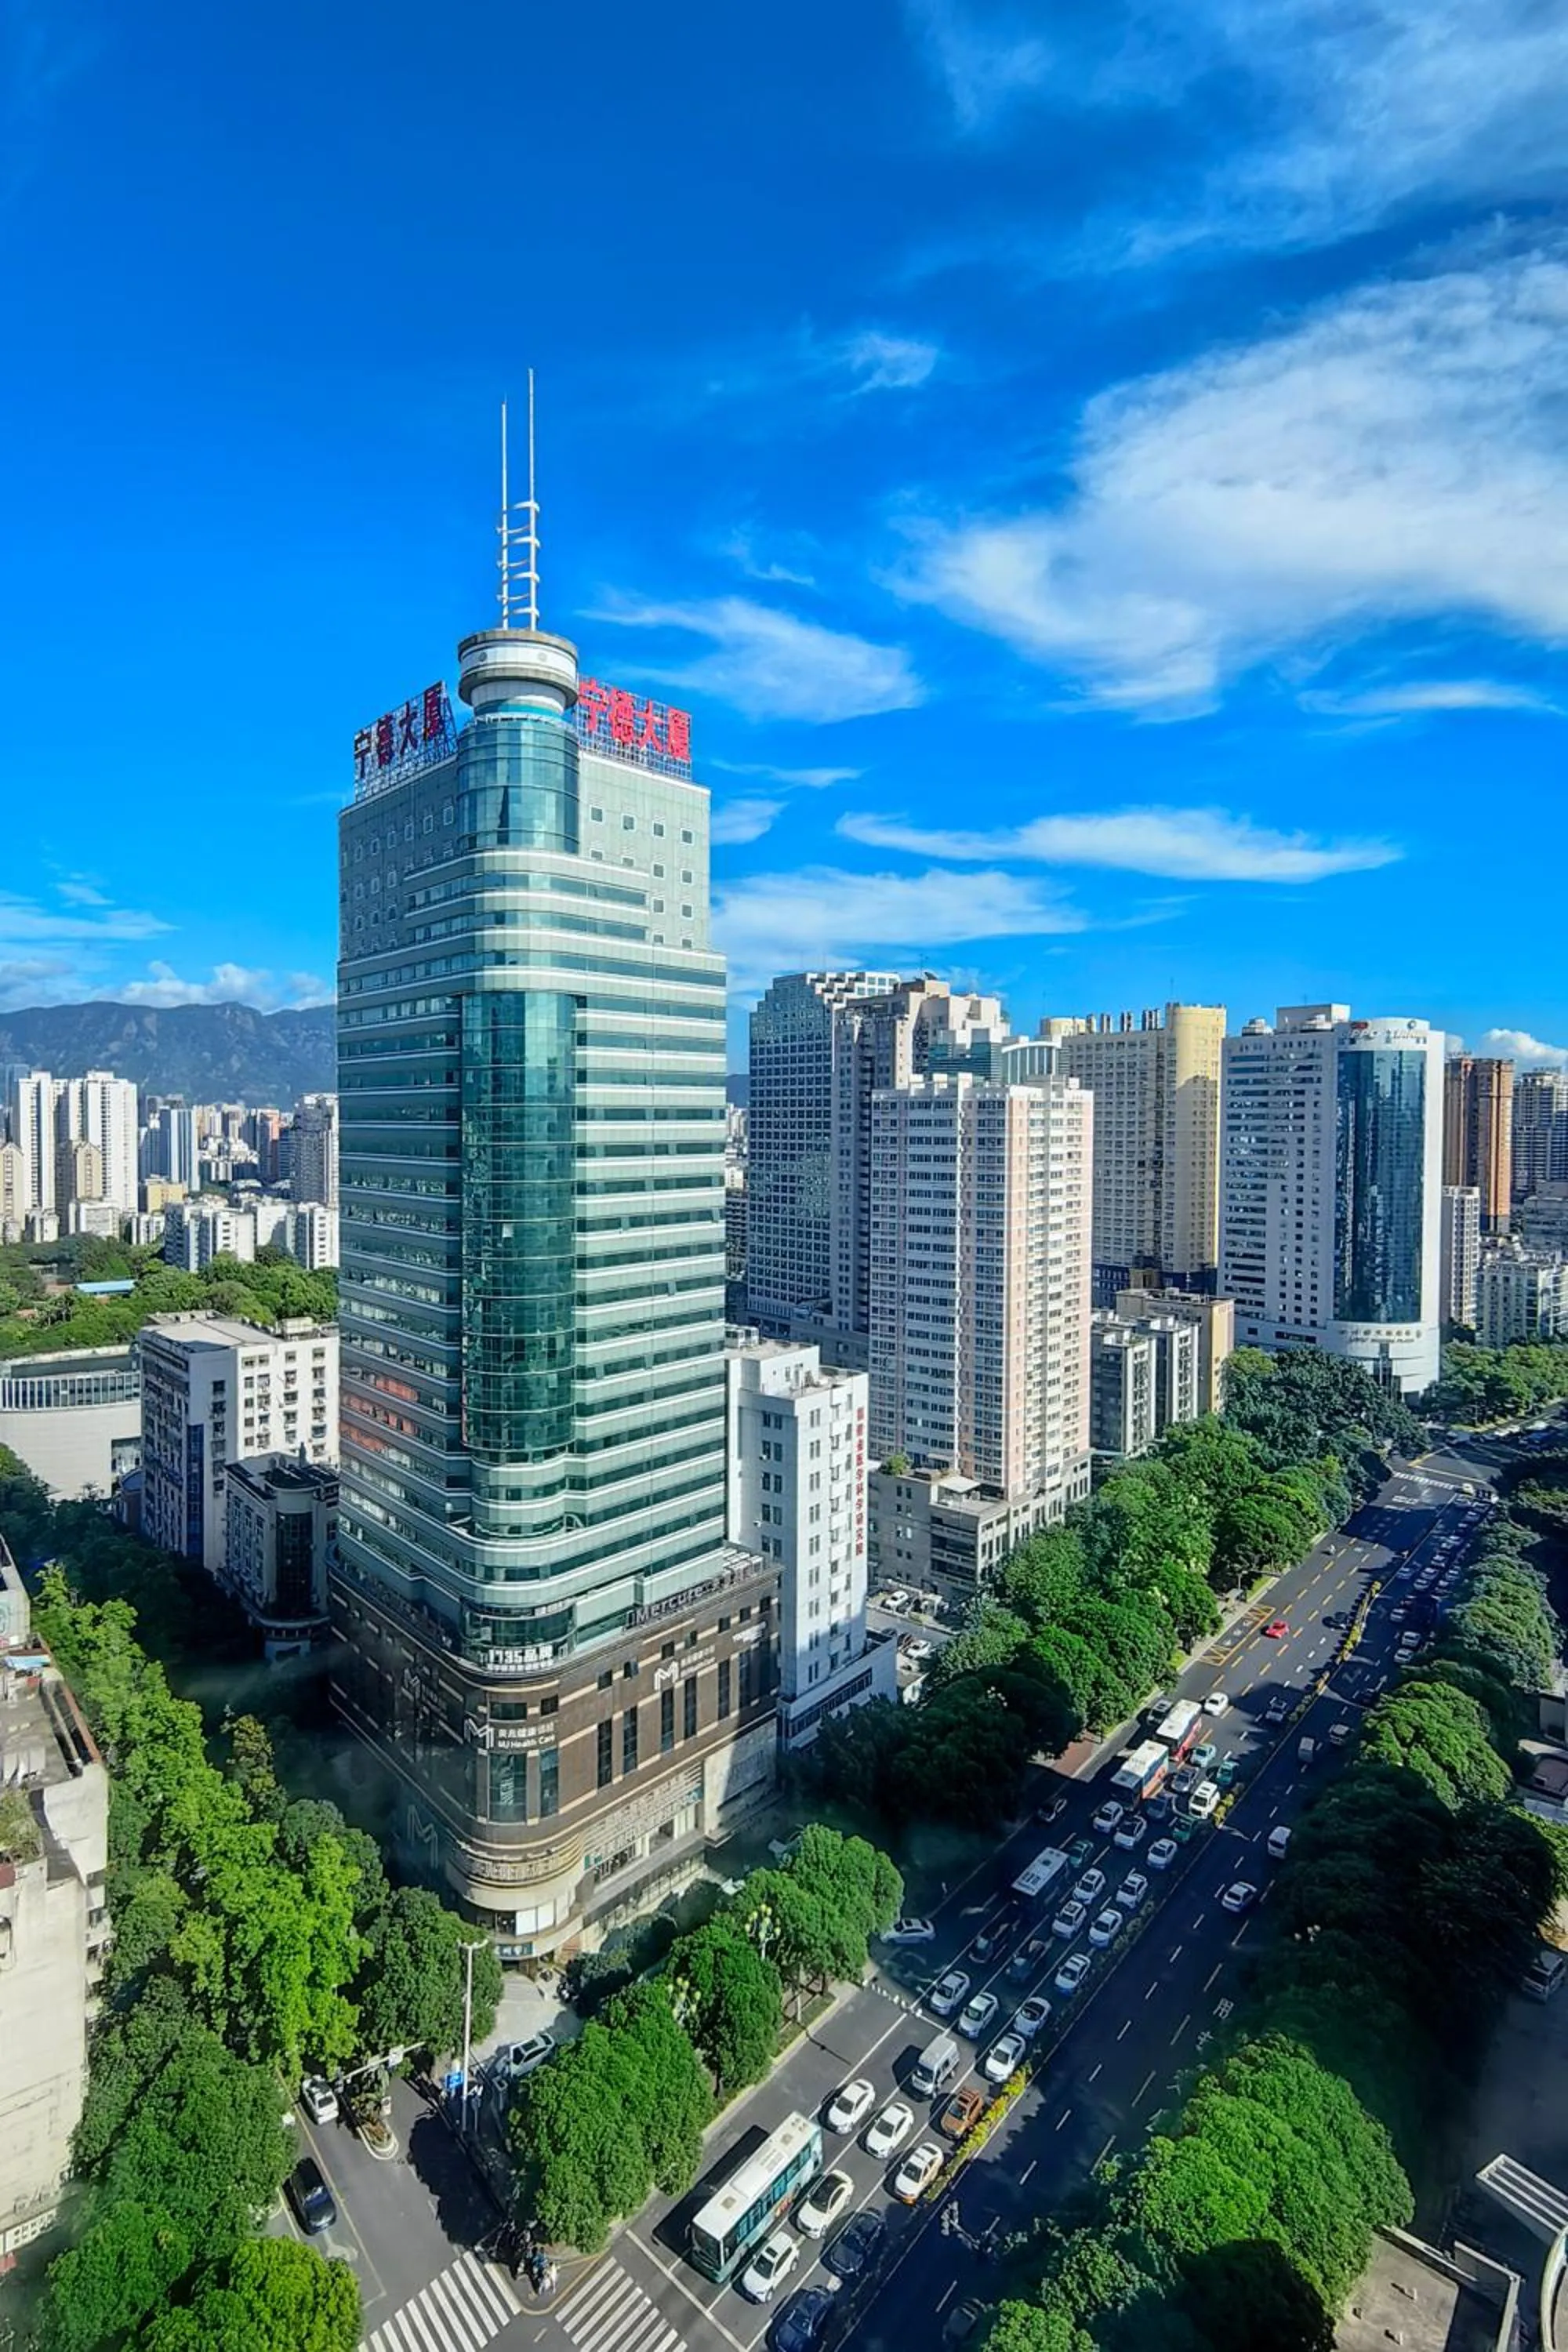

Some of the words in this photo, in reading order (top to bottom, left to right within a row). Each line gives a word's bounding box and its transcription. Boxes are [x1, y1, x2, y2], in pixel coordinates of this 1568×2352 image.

[354, 681, 445, 779] 宁德大厦
[579, 677, 691, 762] 宁德大厦
[637, 1586, 704, 1624] Mercure
